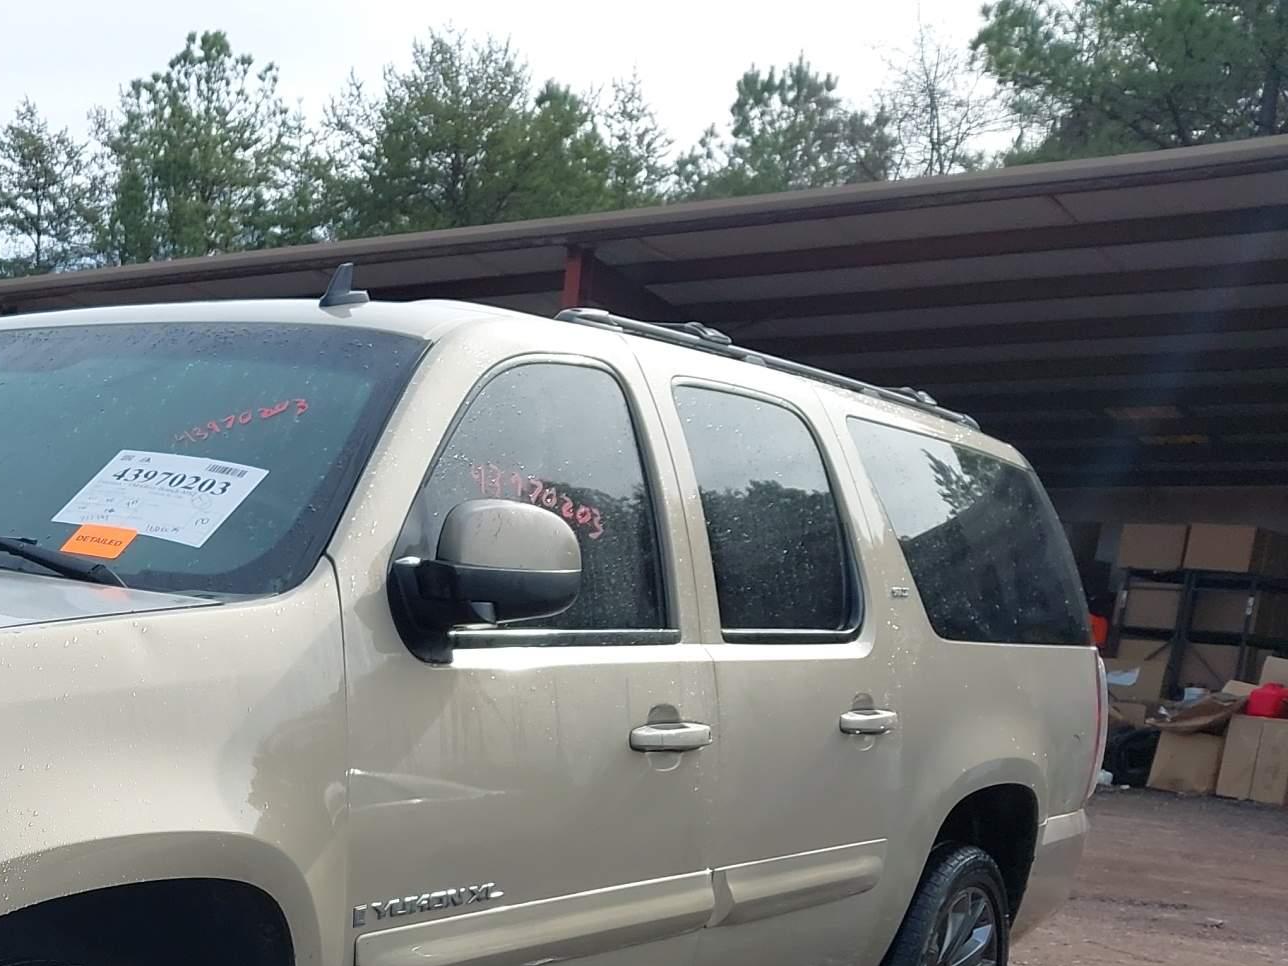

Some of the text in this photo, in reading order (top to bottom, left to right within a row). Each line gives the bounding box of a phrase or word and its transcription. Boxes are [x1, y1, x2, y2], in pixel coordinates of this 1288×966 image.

[112, 467, 231, 495] 43970203
[75, 535, 123, 547] DETAILED
[371, 882, 505, 920] YUKON XL
